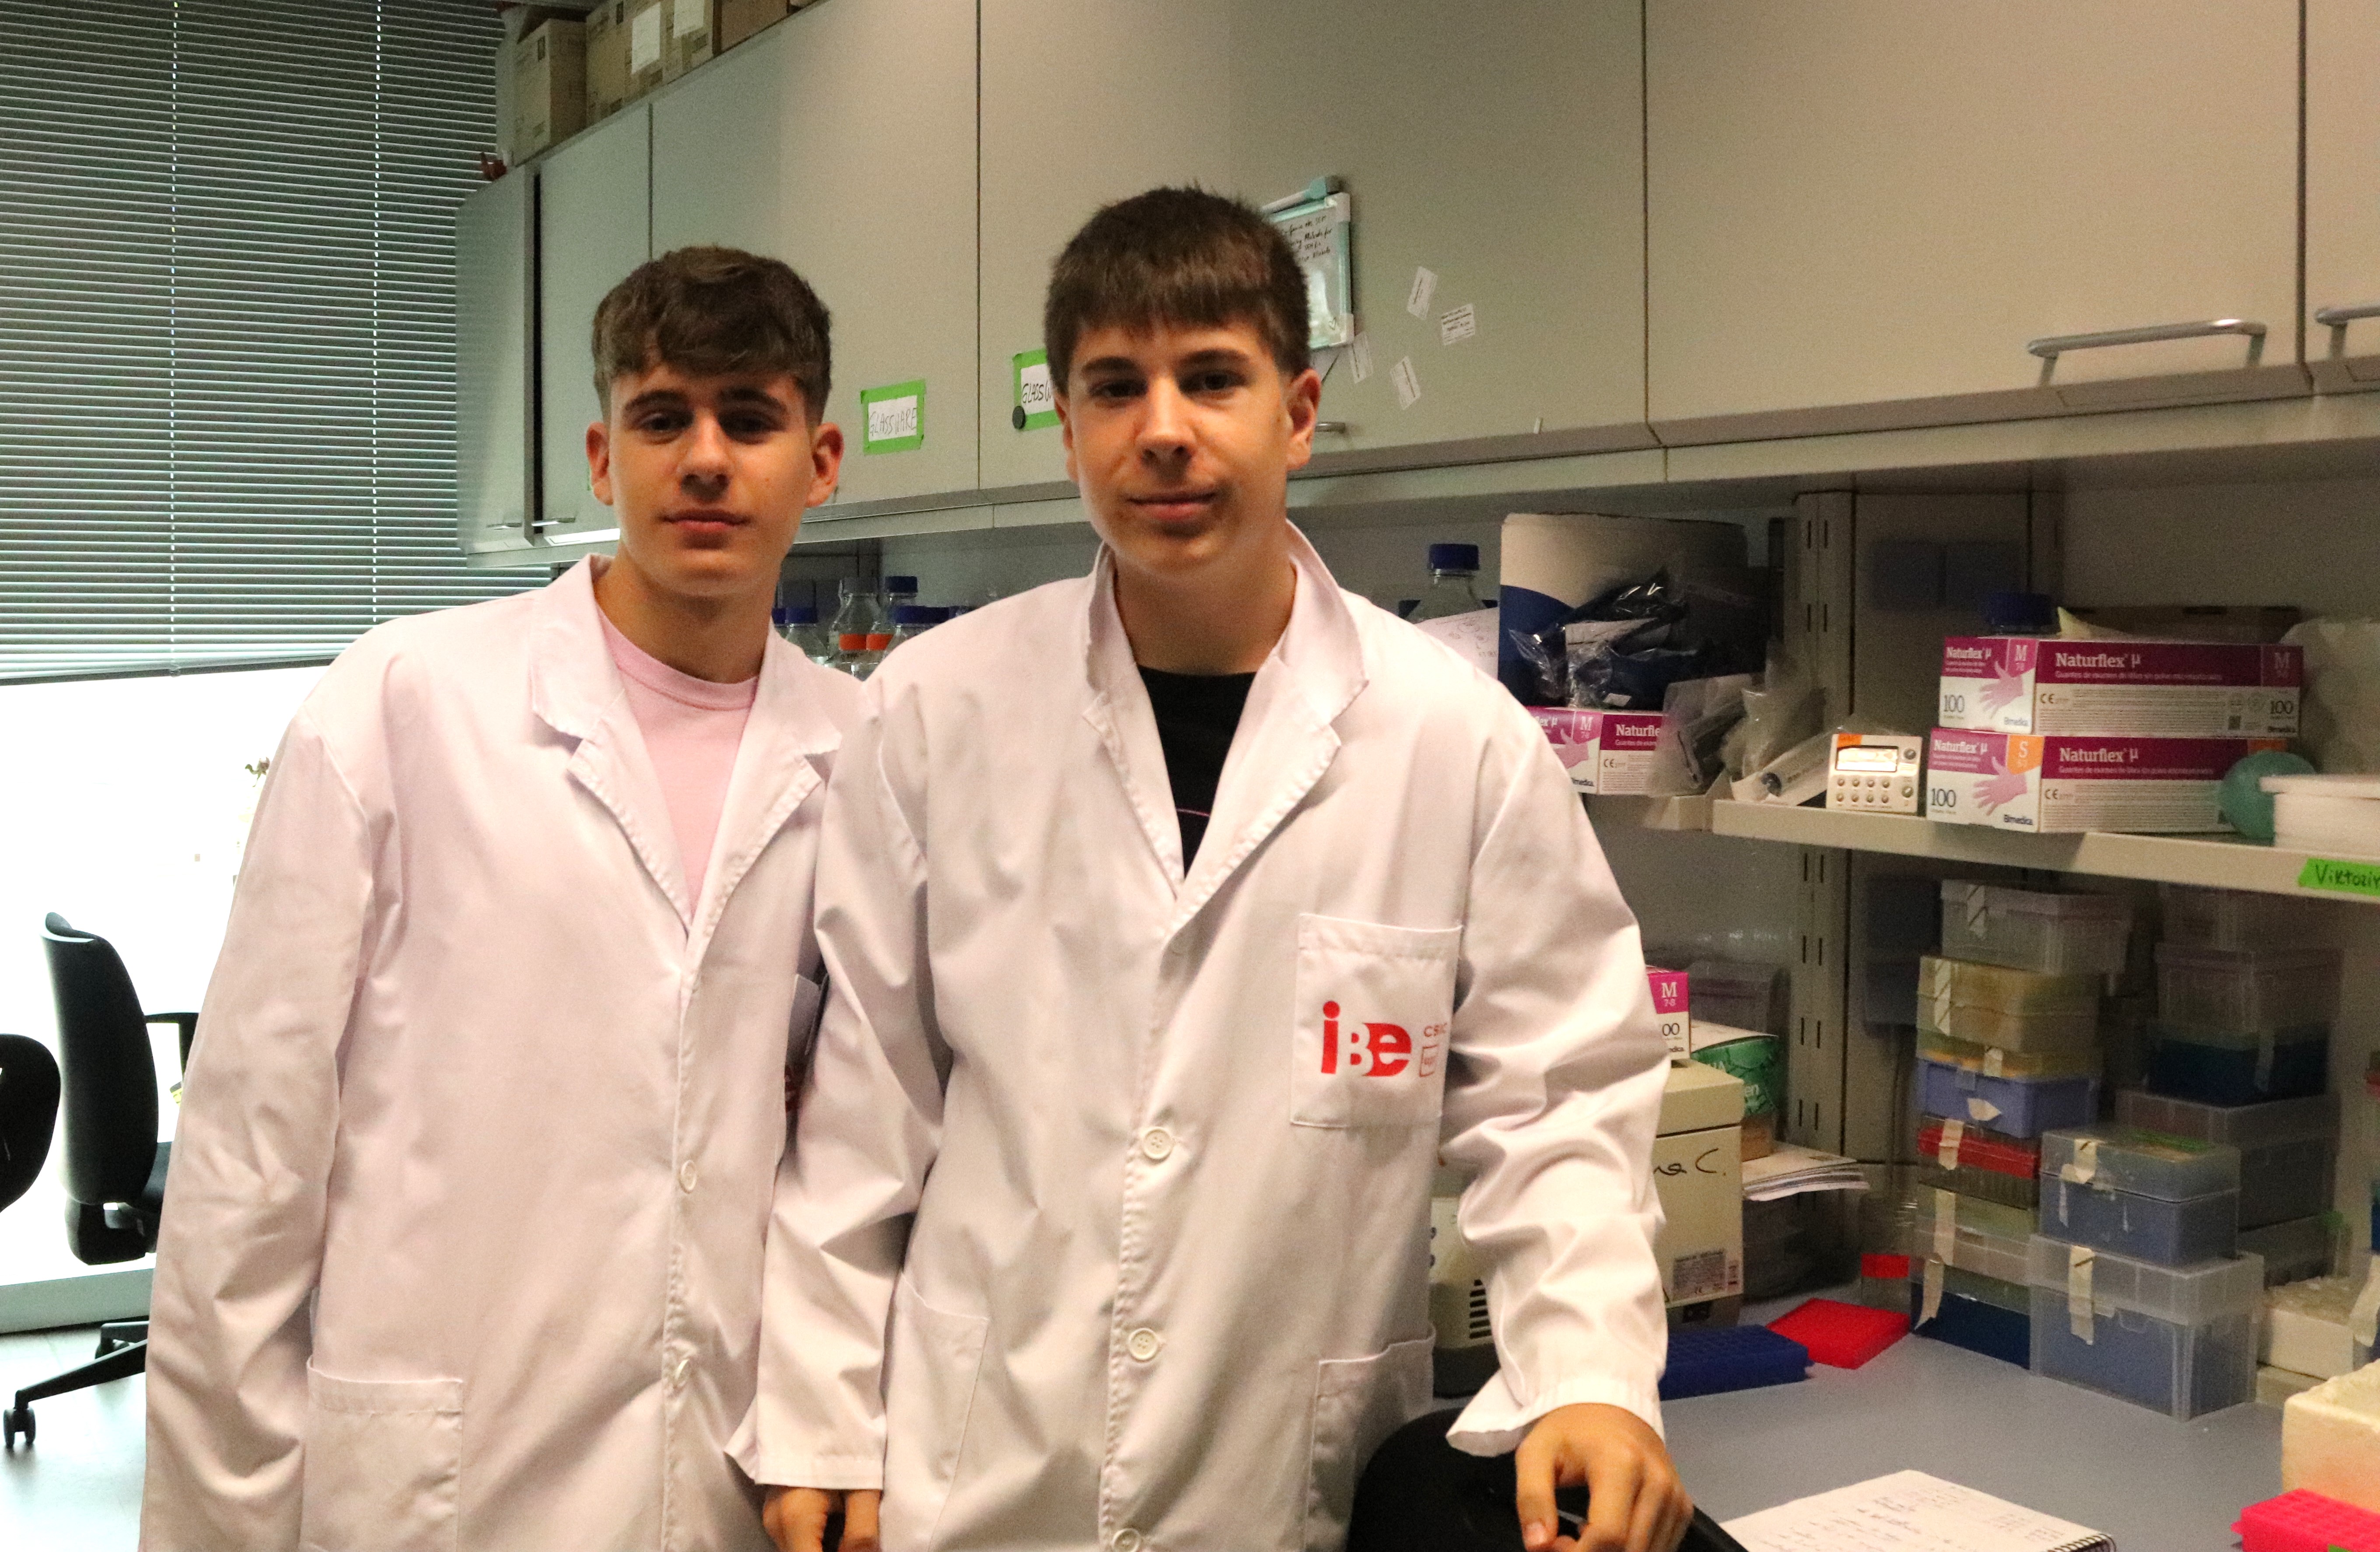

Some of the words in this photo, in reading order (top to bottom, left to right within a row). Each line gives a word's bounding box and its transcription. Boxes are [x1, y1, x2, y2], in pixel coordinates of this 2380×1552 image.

[1022, 379, 1052, 403] GLASSW
[869, 407, 917, 436] GLASSWARE
[2015, 644, 2028, 662] M
[2055, 652, 2125, 668] Naturflex
[2275, 652, 2290, 669] M
[1943, 694, 1965, 713] 100
[2270, 700, 2293, 715] 100
[1580, 716, 1594, 732] M
[1615, 724, 1661, 737] Naturfle
[2018, 741, 2029, 759] S
[2059, 747, 2124, 763] Naturflex
[1931, 788, 1956, 808] 100
[1661, 981, 1678, 998] M
[1662, 1023, 1680, 1036] 00
